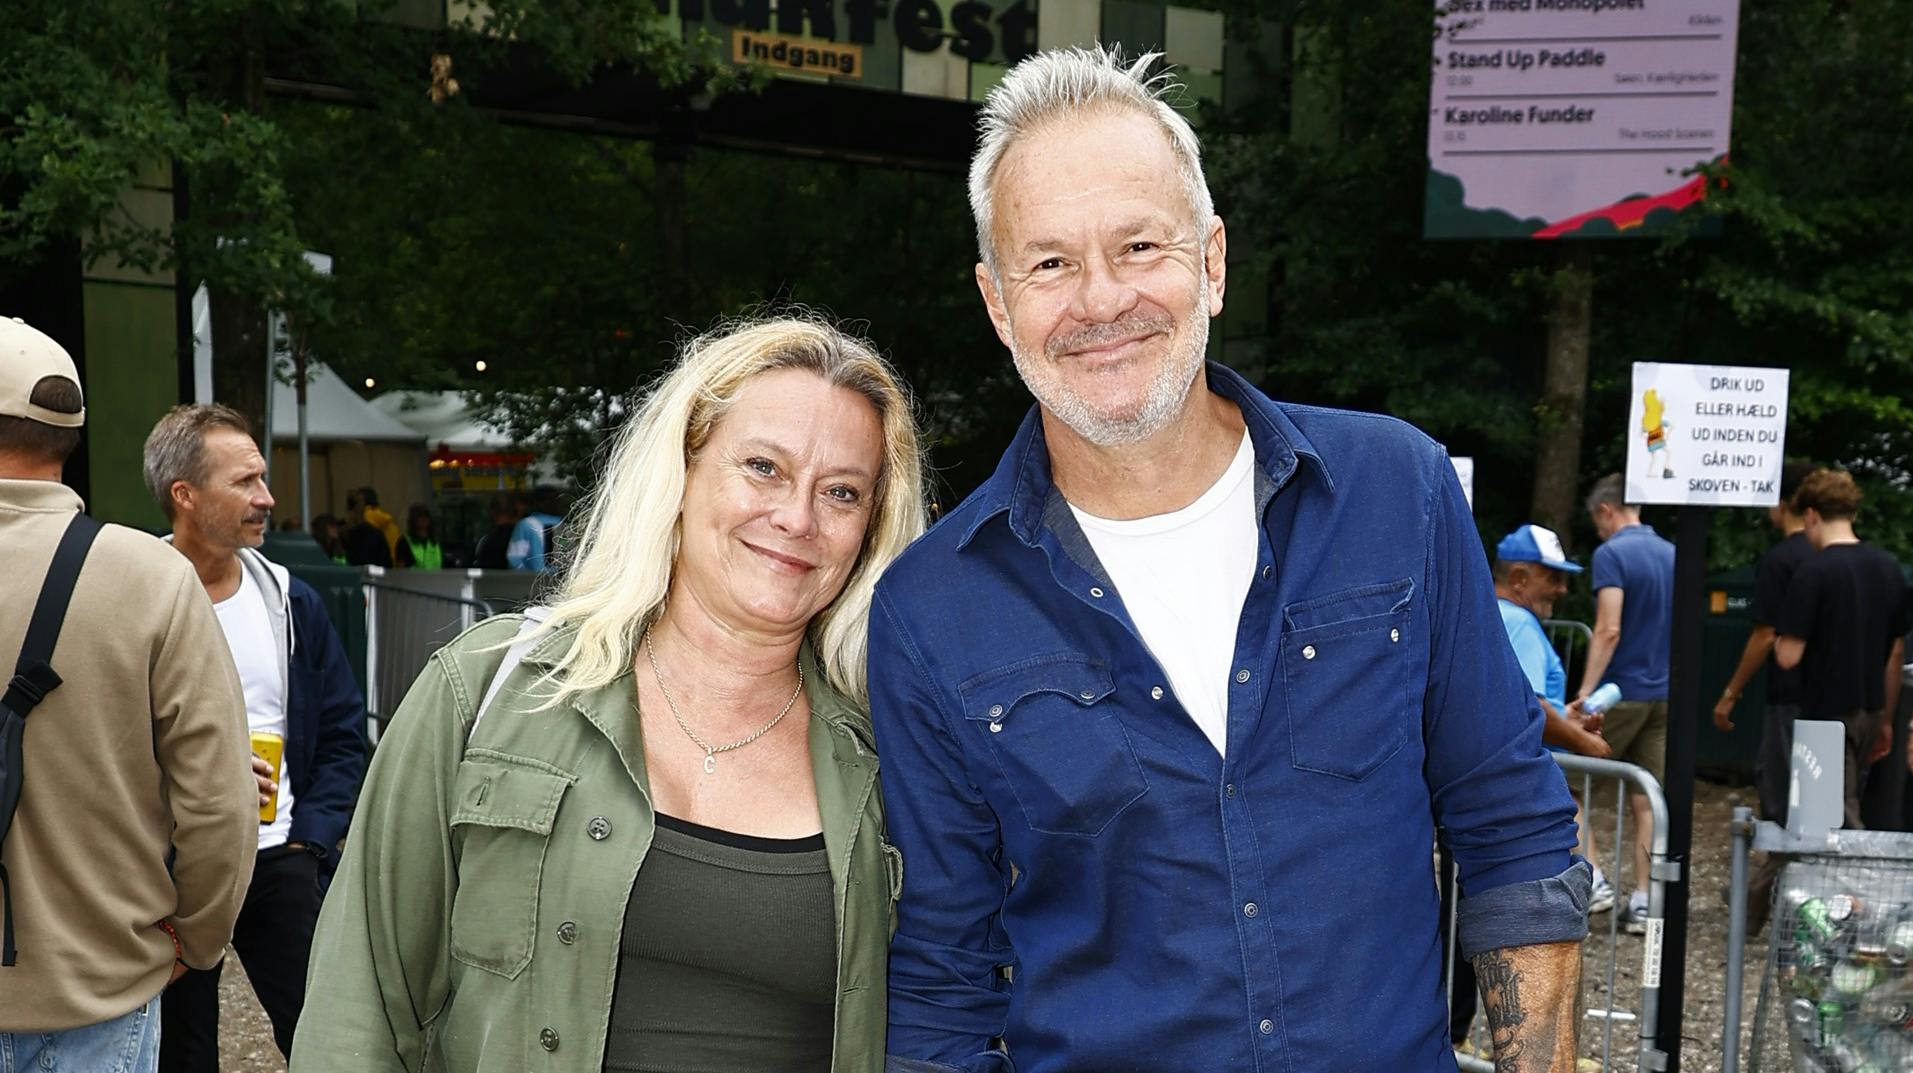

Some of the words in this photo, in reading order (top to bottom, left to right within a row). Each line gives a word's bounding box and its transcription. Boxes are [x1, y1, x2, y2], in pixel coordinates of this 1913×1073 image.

[1487, 0, 1531, 12] med
[741, 35, 856, 74] Indgang
[1448, 50, 1502, 68] Stand
[1507, 49, 1534, 71] Up
[1539, 49, 1605, 67] Paddle
[1445, 106, 1524, 124] Karoline
[1528, 105, 1595, 123] Funder
[1711, 377, 1742, 391] DRIK
[1745, 379, 1765, 392] UD
[1696, 402, 1733, 416] ELLER
[1736, 405, 1777, 418] HÆLD
[1692, 428, 1710, 441] UD
[1714, 429, 1754, 442] INDEN
[1758, 431, 1778, 443] DU
[1702, 450, 1729, 467] GÅR
[1732, 454, 1756, 468] IND
[1759, 455, 1763, 468] I
[1689, 478, 1740, 492] SKOVEN
[1751, 480, 1774, 493] TAK
